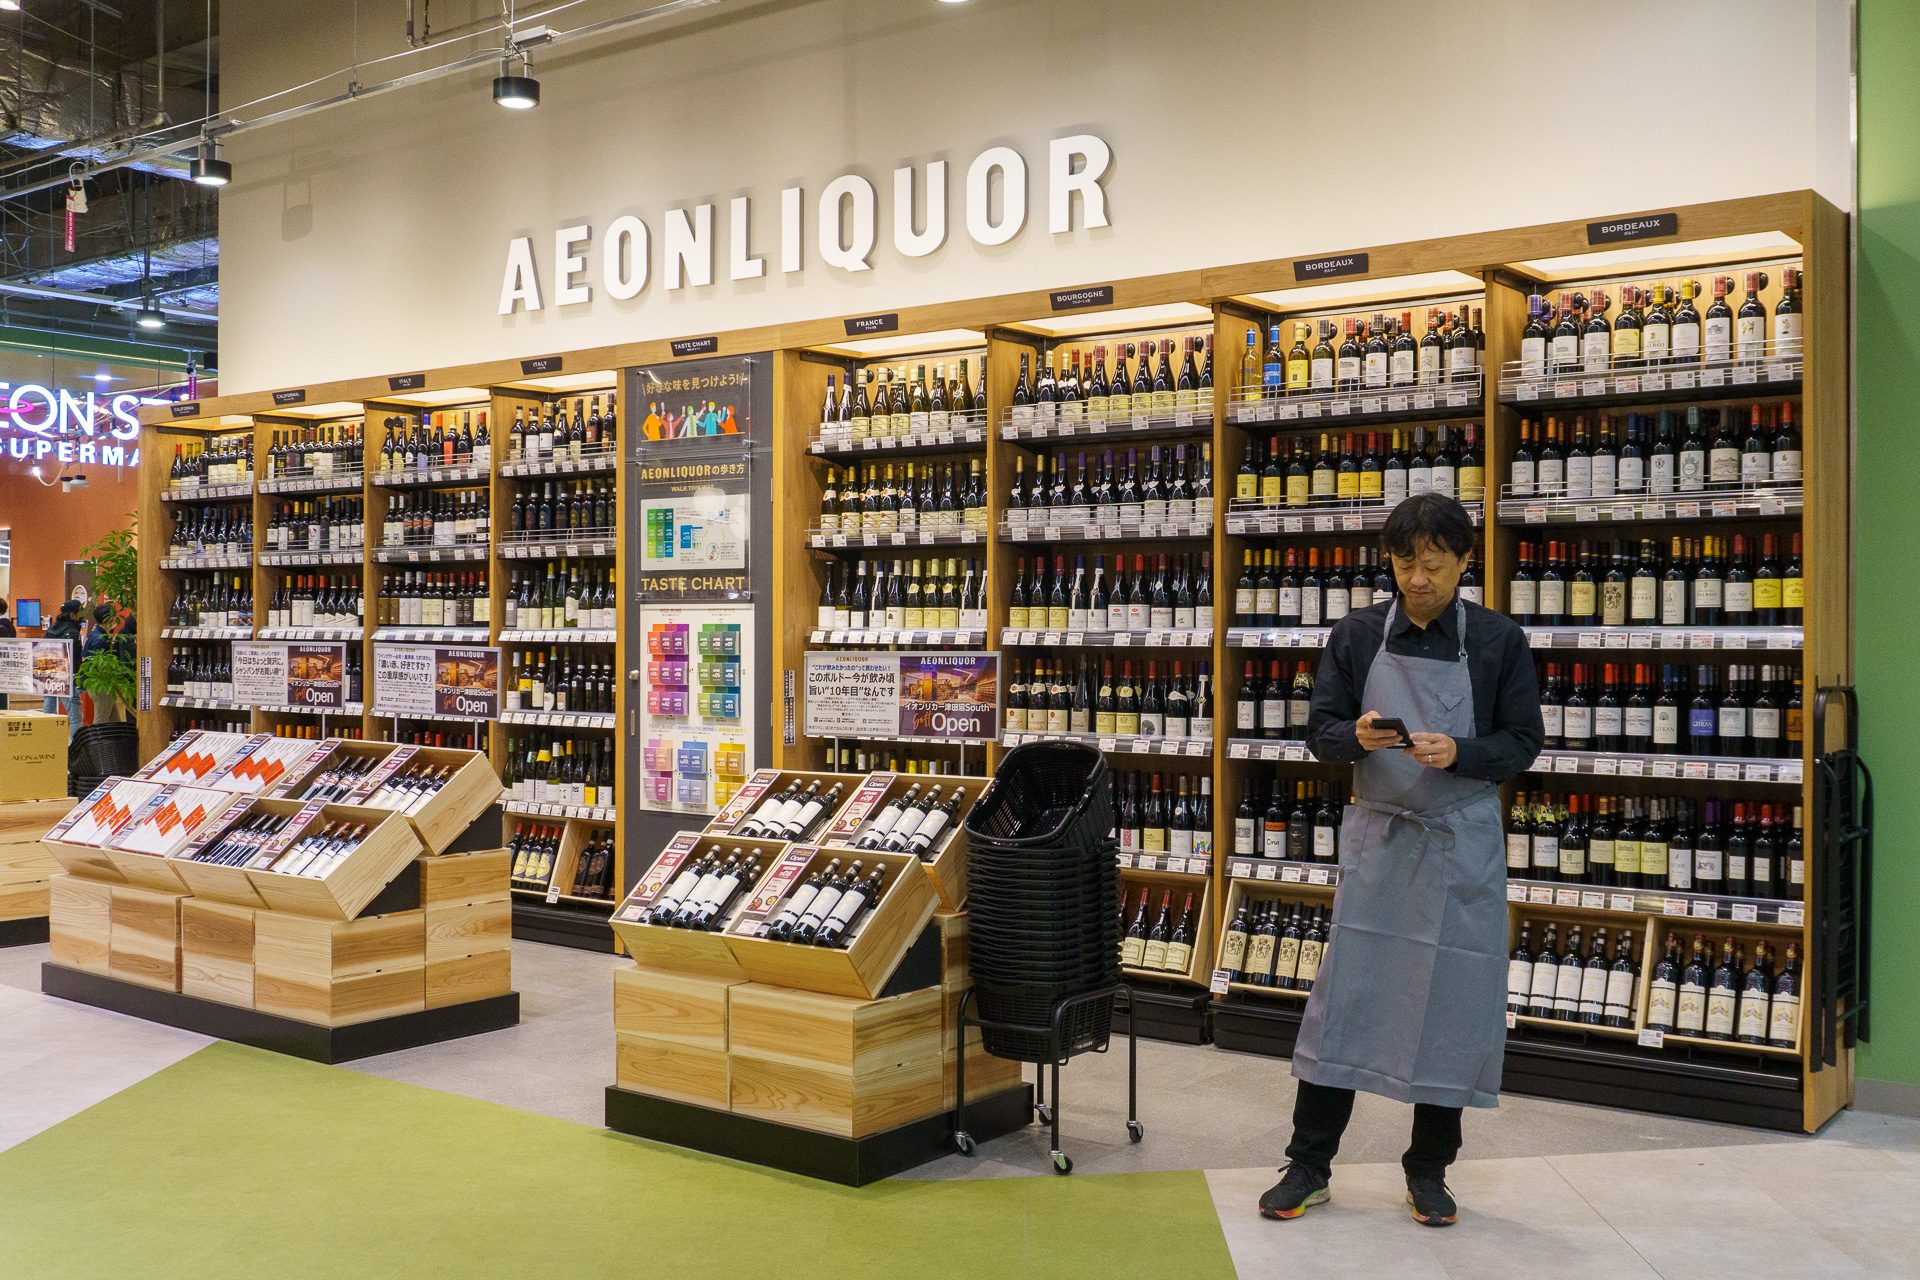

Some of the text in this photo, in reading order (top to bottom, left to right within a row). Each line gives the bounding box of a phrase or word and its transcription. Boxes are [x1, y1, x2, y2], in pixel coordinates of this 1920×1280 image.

[498, 134, 1112, 315] AEONLIQUOR
[1602, 220, 1660, 234] BORDEAUX
[1306, 258, 1354, 271] BORDEAUX
[1057, 290, 1104, 302] BOURGOGNE
[856, 319, 883, 327] FRANCE
[674, 340, 711, 350] TASTE CHART
[641, 463, 745, 480] AEONLIQUORの歩き方
[641, 576, 745, 591] TASTE CHART
[448, 650, 485, 658] AEONLIQUOR
[920, 657, 976, 665] AEONLIQUOR
[809, 672, 895, 684] このボルドー今が飲み頃
[305, 688, 334, 705] Open
[456, 696, 488, 716] Open
[931, 712, 981, 736] Open
